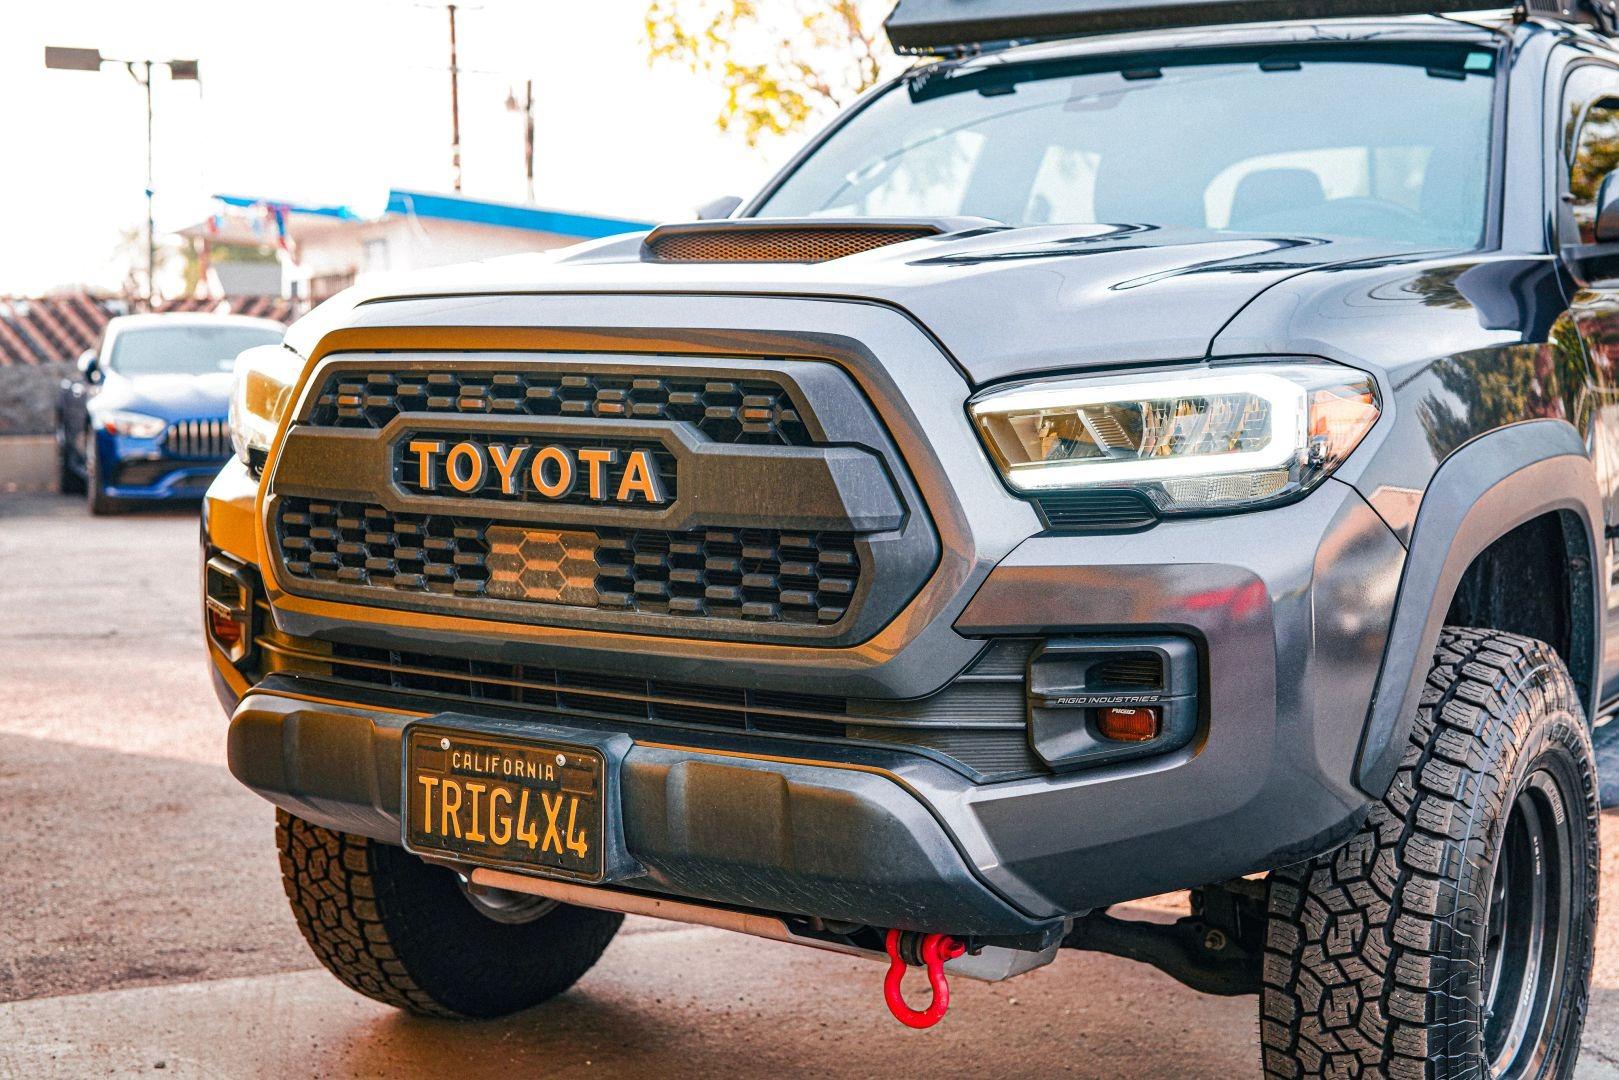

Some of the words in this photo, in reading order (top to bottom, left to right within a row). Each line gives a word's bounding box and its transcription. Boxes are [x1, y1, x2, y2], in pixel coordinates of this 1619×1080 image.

[410, 440, 665, 503] TOYOTA
[1088, 696, 1159, 704] INDUSTRIES
[452, 752, 554, 781] CALIFORNIA
[418, 775, 588, 858] TRIG4X4
